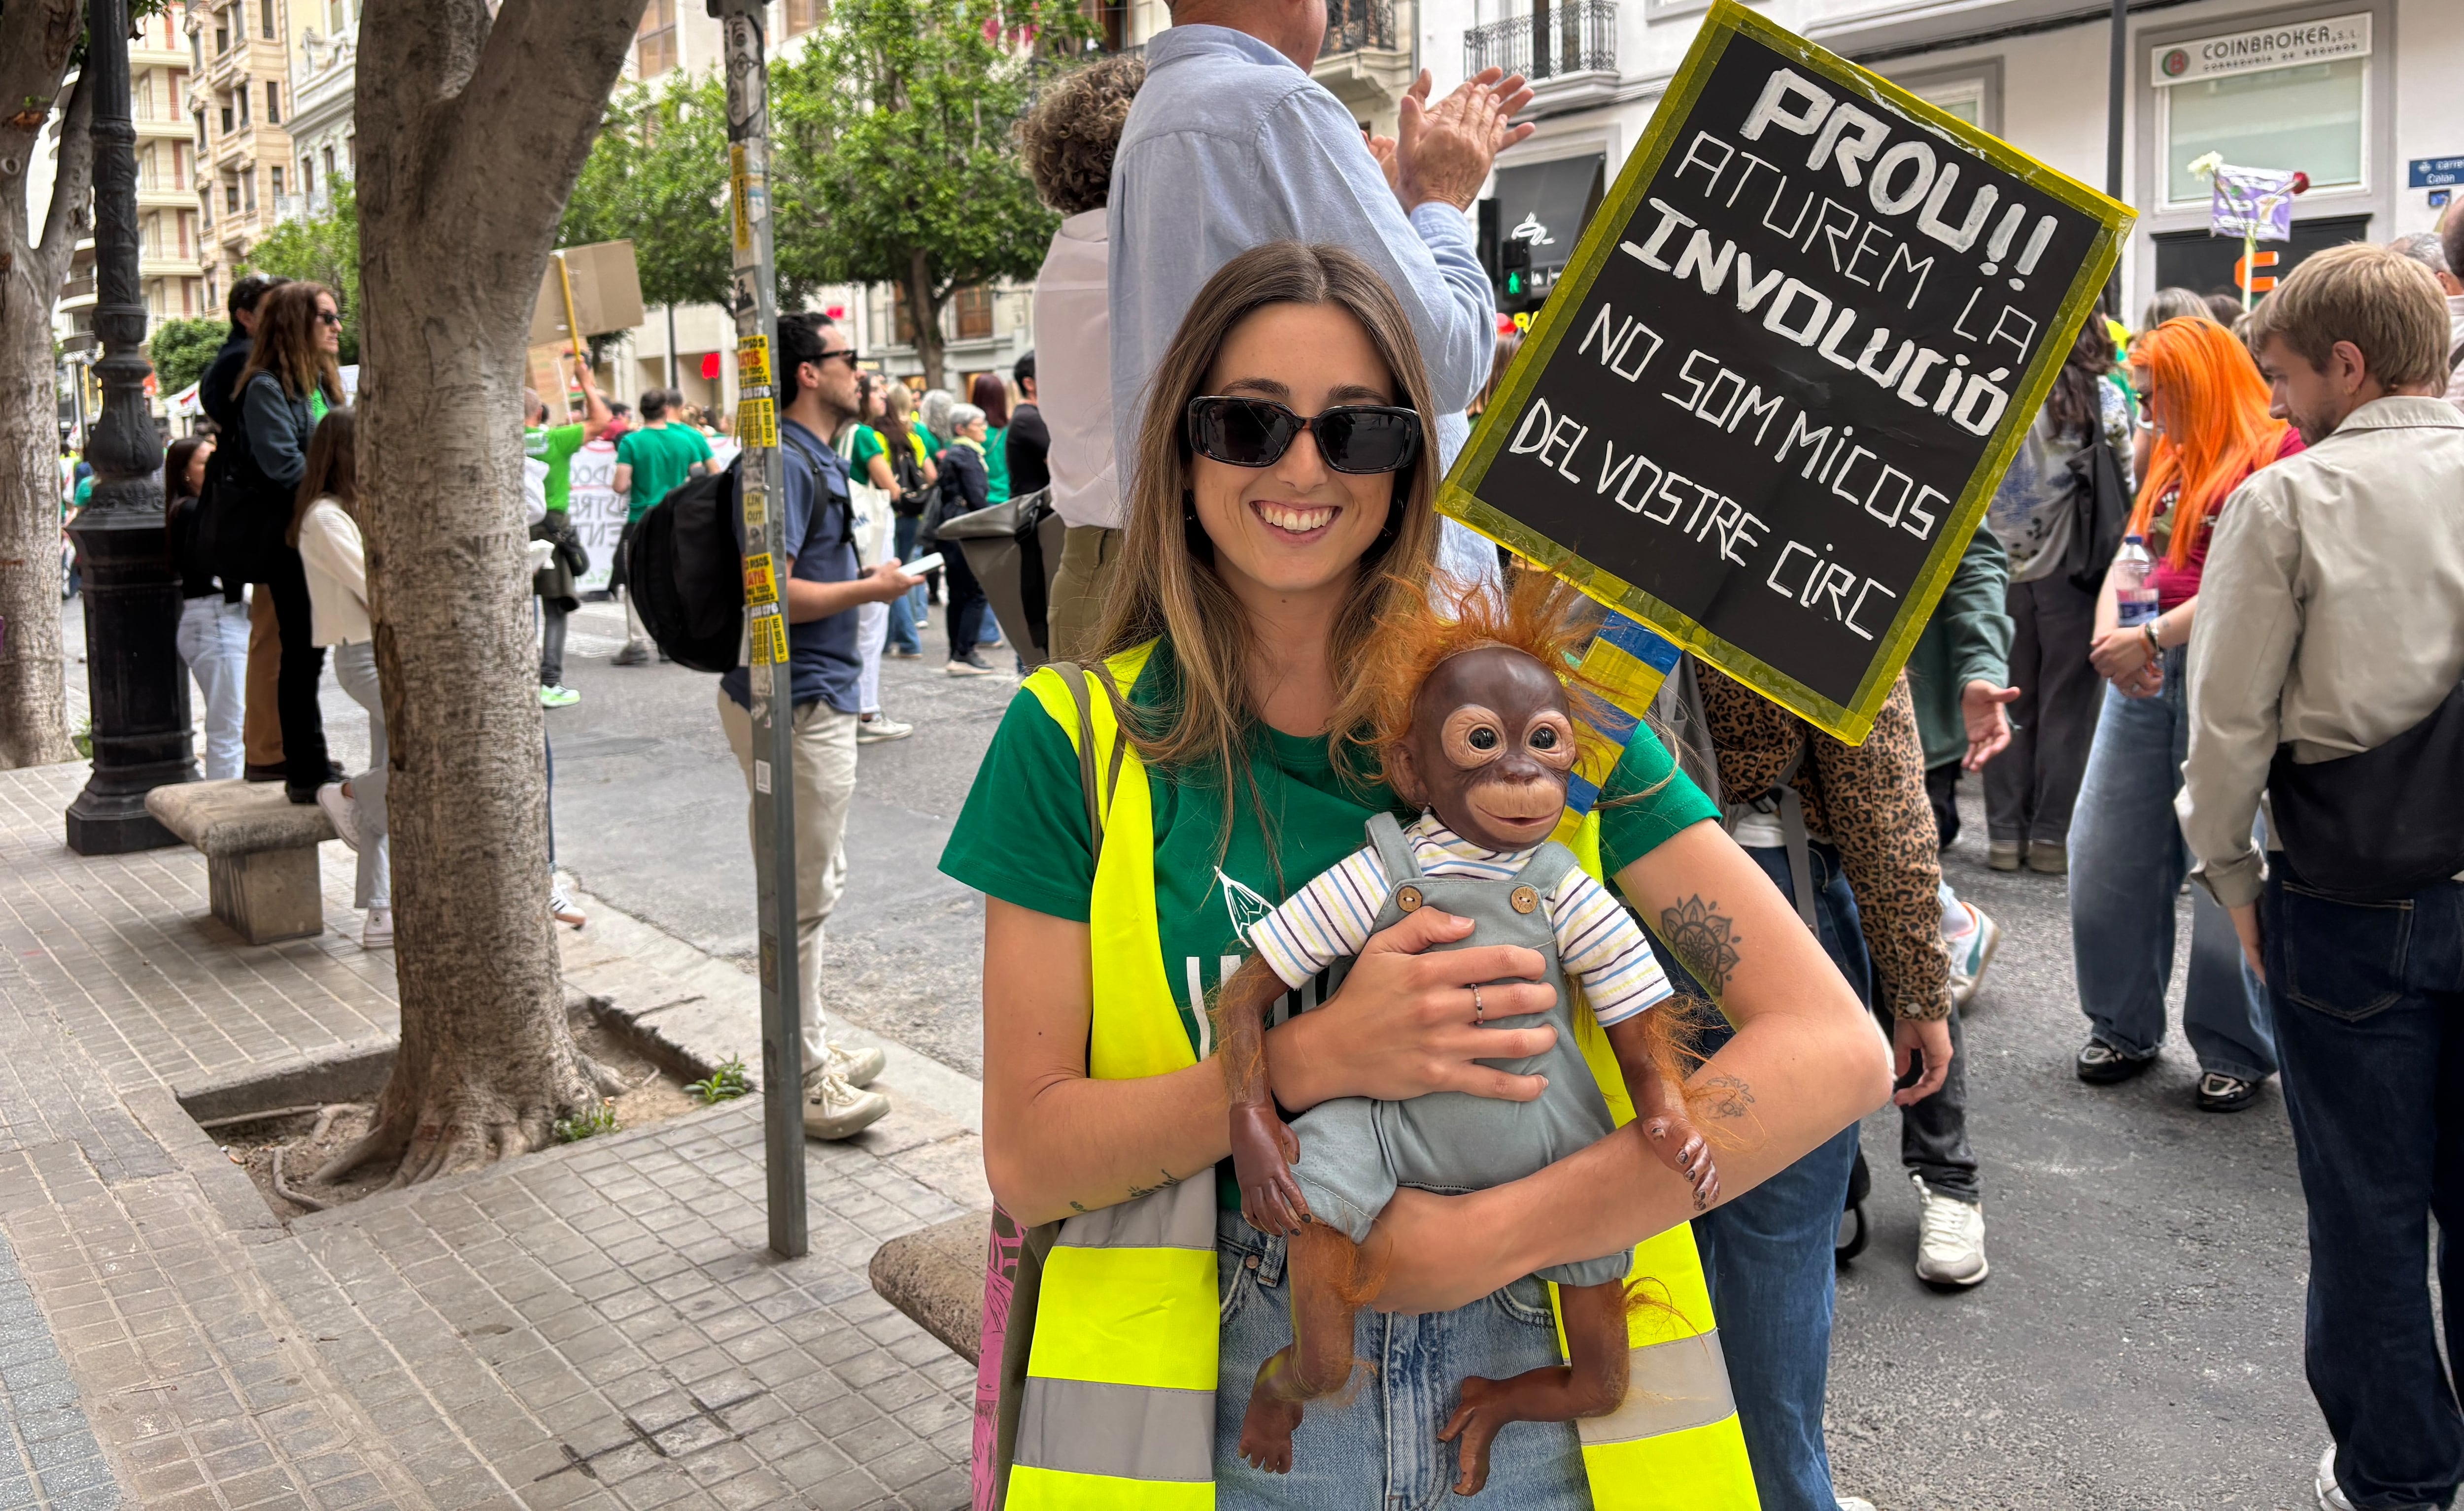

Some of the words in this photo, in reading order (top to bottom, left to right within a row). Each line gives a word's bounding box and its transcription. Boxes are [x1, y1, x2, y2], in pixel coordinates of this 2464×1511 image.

[1675, 131, 1934, 309] ATUREM
[1953, 287, 2037, 364] LA
[1740, 68, 2058, 291] PROU!!
[1578, 303, 1664, 382] NO
[1662, 350, 1784, 446] SOM
[1509, 398, 1588, 483] DEL
[1597, 440, 1770, 567] VOSTRE
